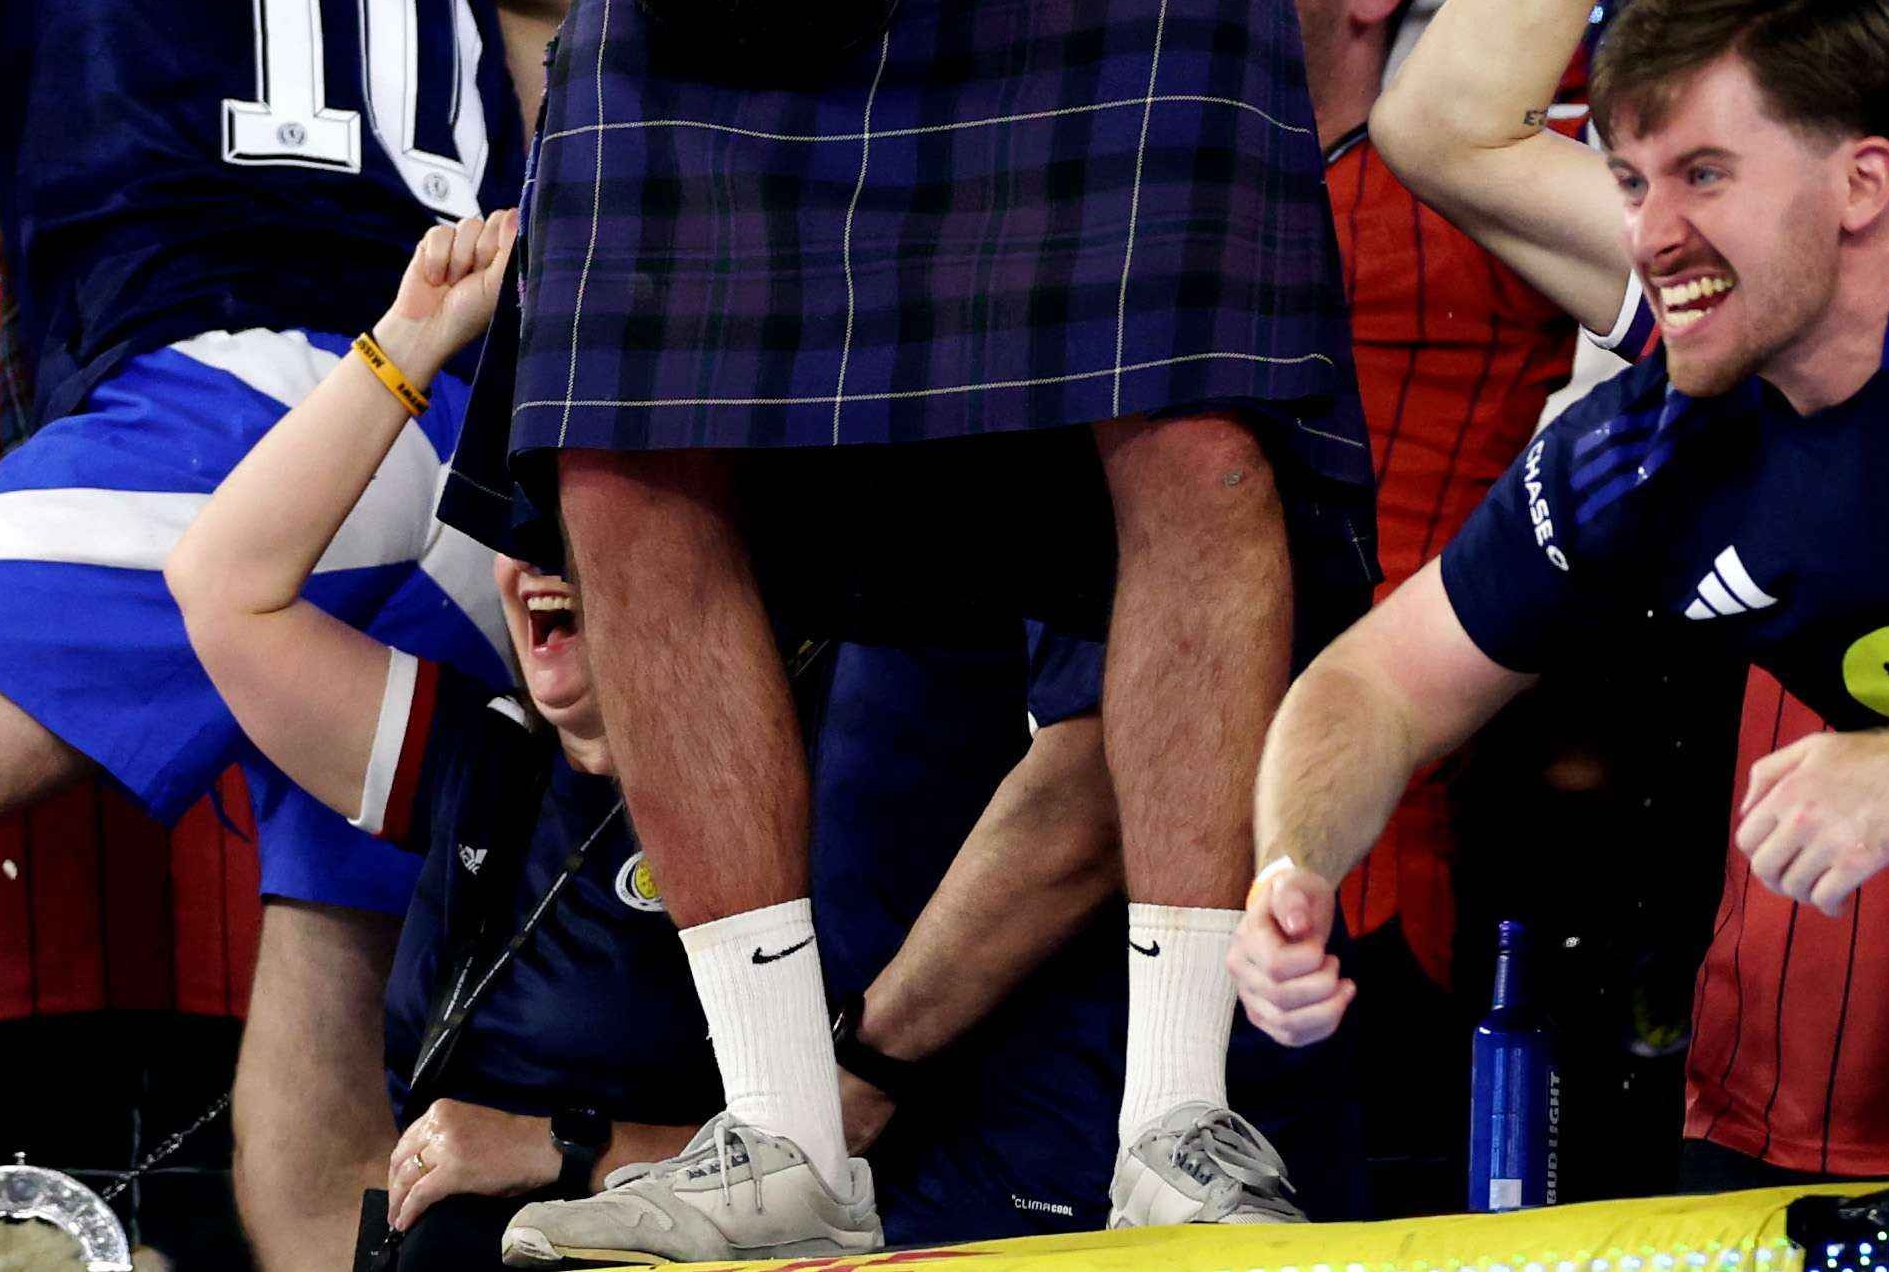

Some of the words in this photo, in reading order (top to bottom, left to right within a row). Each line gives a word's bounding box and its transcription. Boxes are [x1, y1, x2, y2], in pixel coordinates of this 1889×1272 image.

[1523, 439, 1554, 548] CHASE
[1548, 1071, 1561, 1148] LIGHT
[1546, 1151, 1558, 1205] BUD
